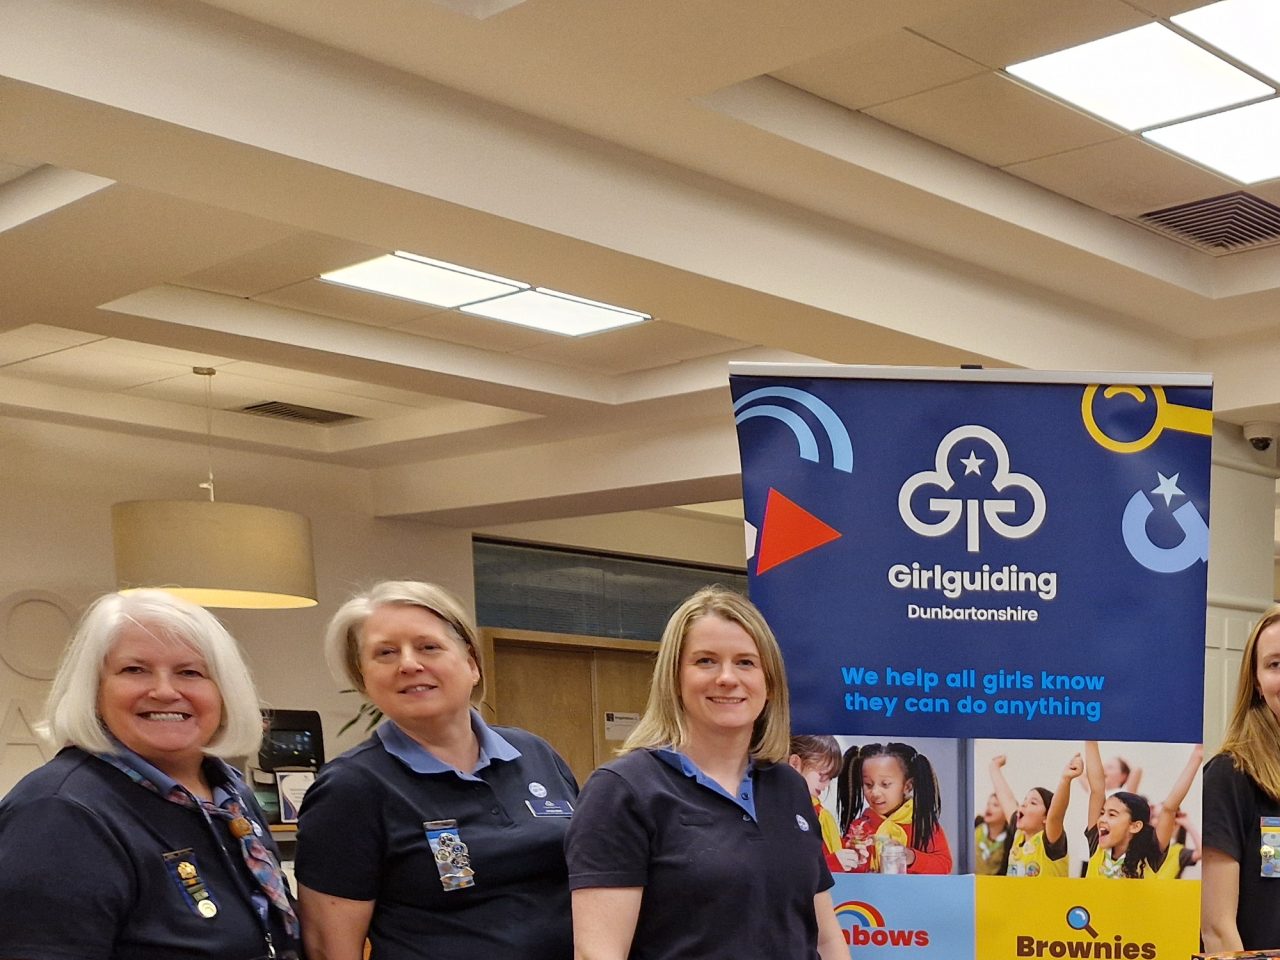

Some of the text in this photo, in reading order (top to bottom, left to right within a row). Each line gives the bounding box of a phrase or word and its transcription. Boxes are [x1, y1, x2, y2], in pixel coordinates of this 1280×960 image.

[888, 562, 1057, 599] Girlguiding
[907, 604, 1038, 622] Dunbartonshire
[841, 667, 1105, 694] We help all girls know
[844, 693, 1102, 722] they can do anything
[1016, 935, 1157, 960] Brownies
